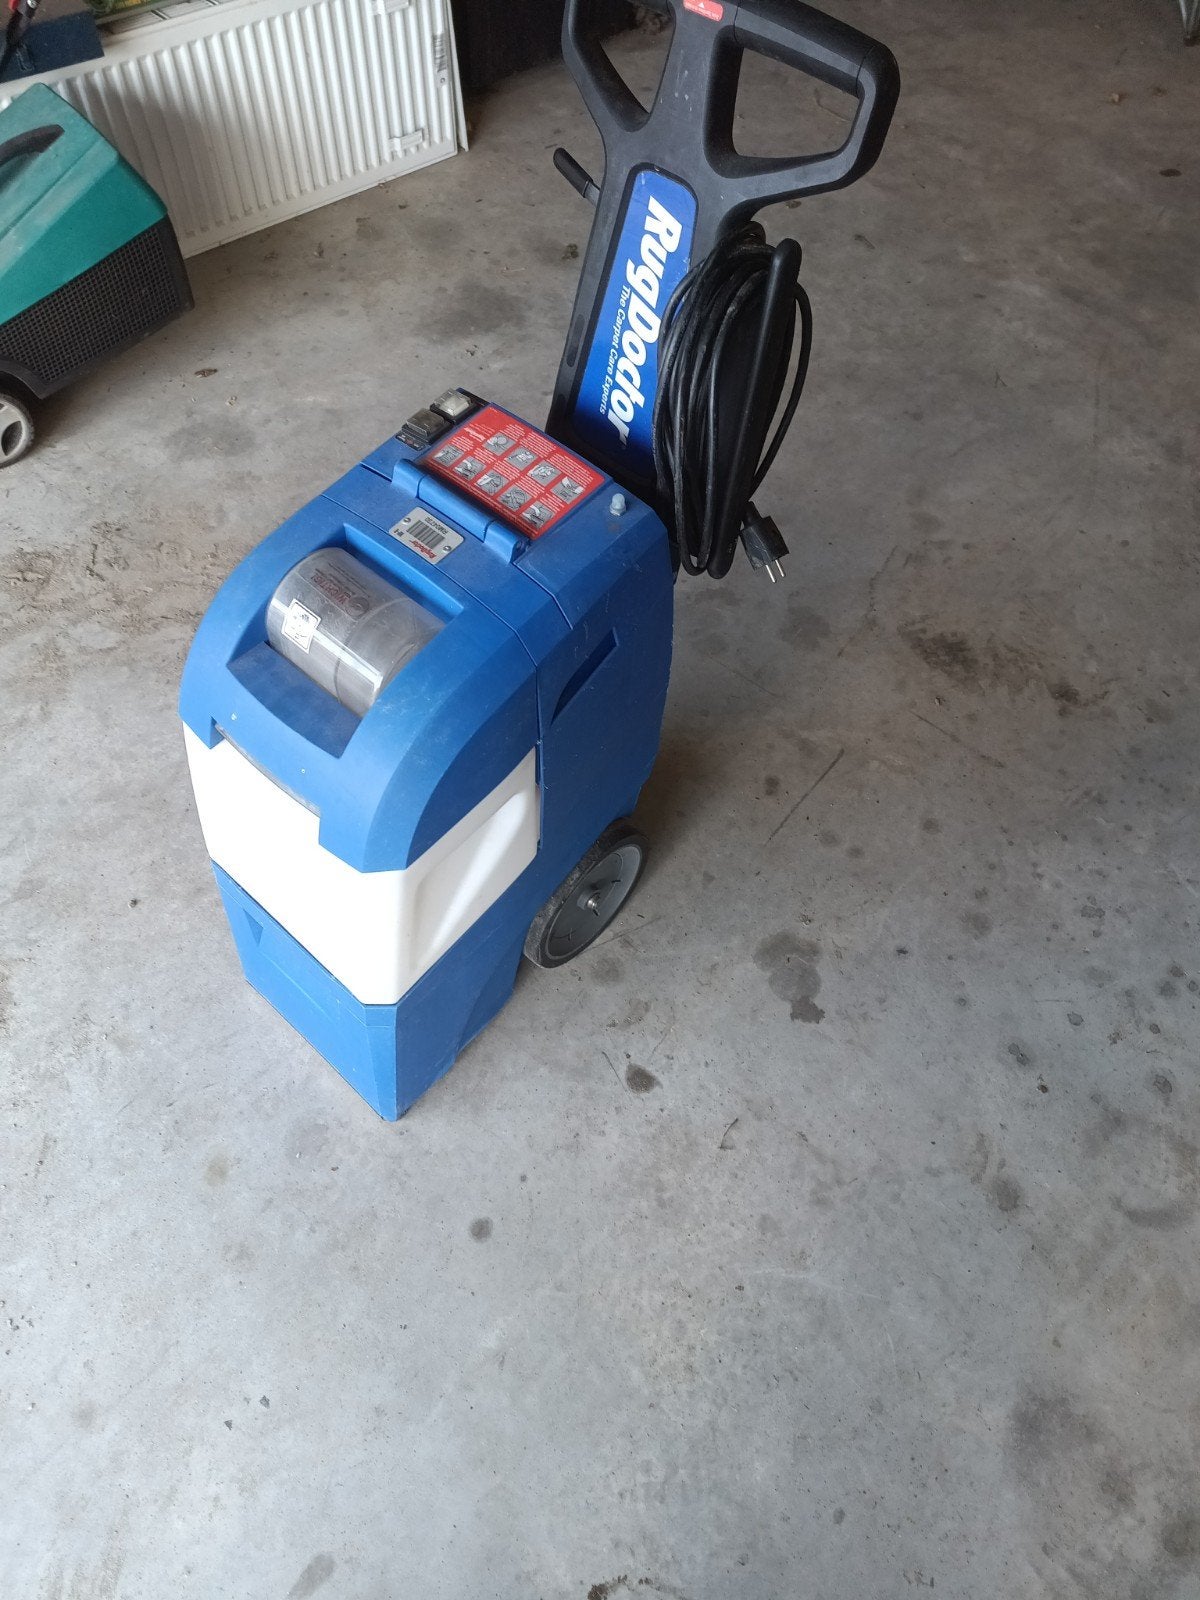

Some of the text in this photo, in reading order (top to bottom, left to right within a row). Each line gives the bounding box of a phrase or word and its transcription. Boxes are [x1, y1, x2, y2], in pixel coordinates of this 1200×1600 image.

[599, 284, 631, 415] The Carpet Care Experts
